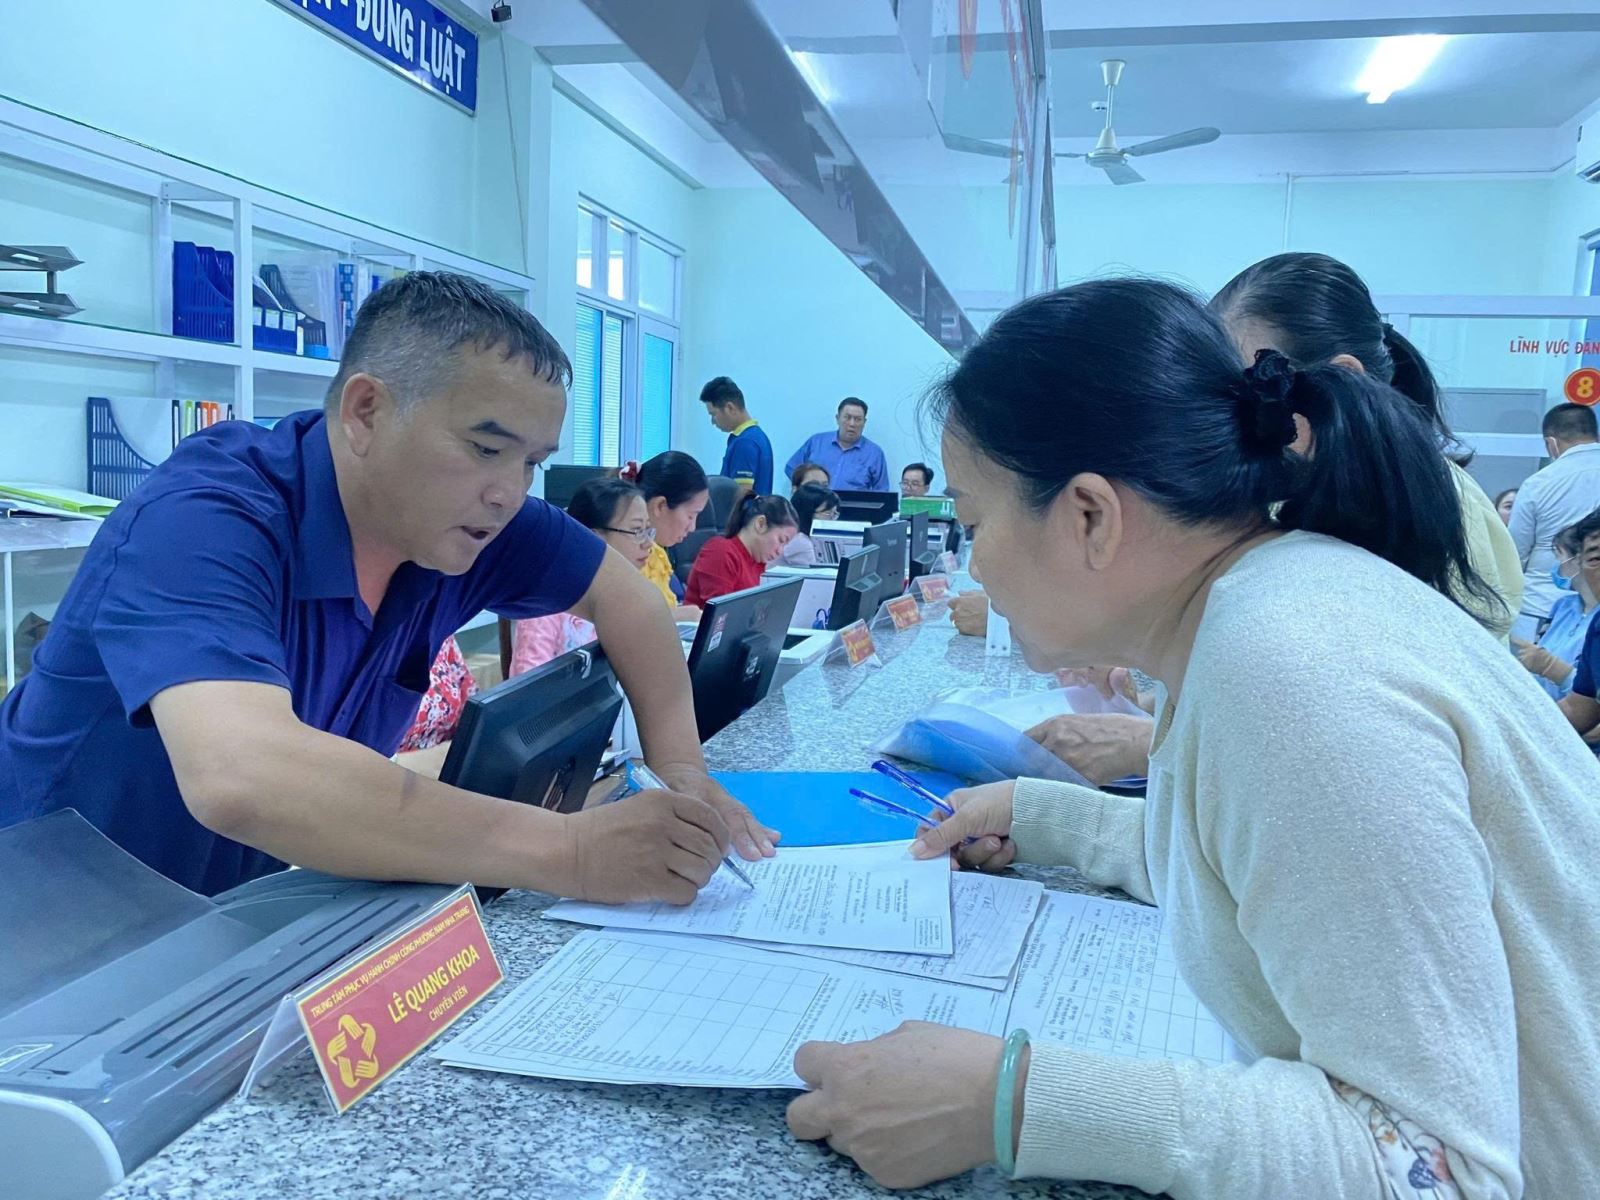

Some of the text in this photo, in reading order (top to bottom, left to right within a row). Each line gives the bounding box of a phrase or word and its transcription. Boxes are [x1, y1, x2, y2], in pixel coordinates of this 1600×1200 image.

[419, 19, 466, 94] LUẬT
[1510, 336, 1540, 354] LĨNH
[1545, 339, 1570, 357] VỰC
[1576, 376, 1594, 398] 8
[387, 944, 481, 1024] LÊ QUANG KHOA
[311, 996, 333, 1018] TRUNG
[330, 991, 346, 1006] TÂM
[429, 985, 468, 1021] CHUYÊN VIÊN
